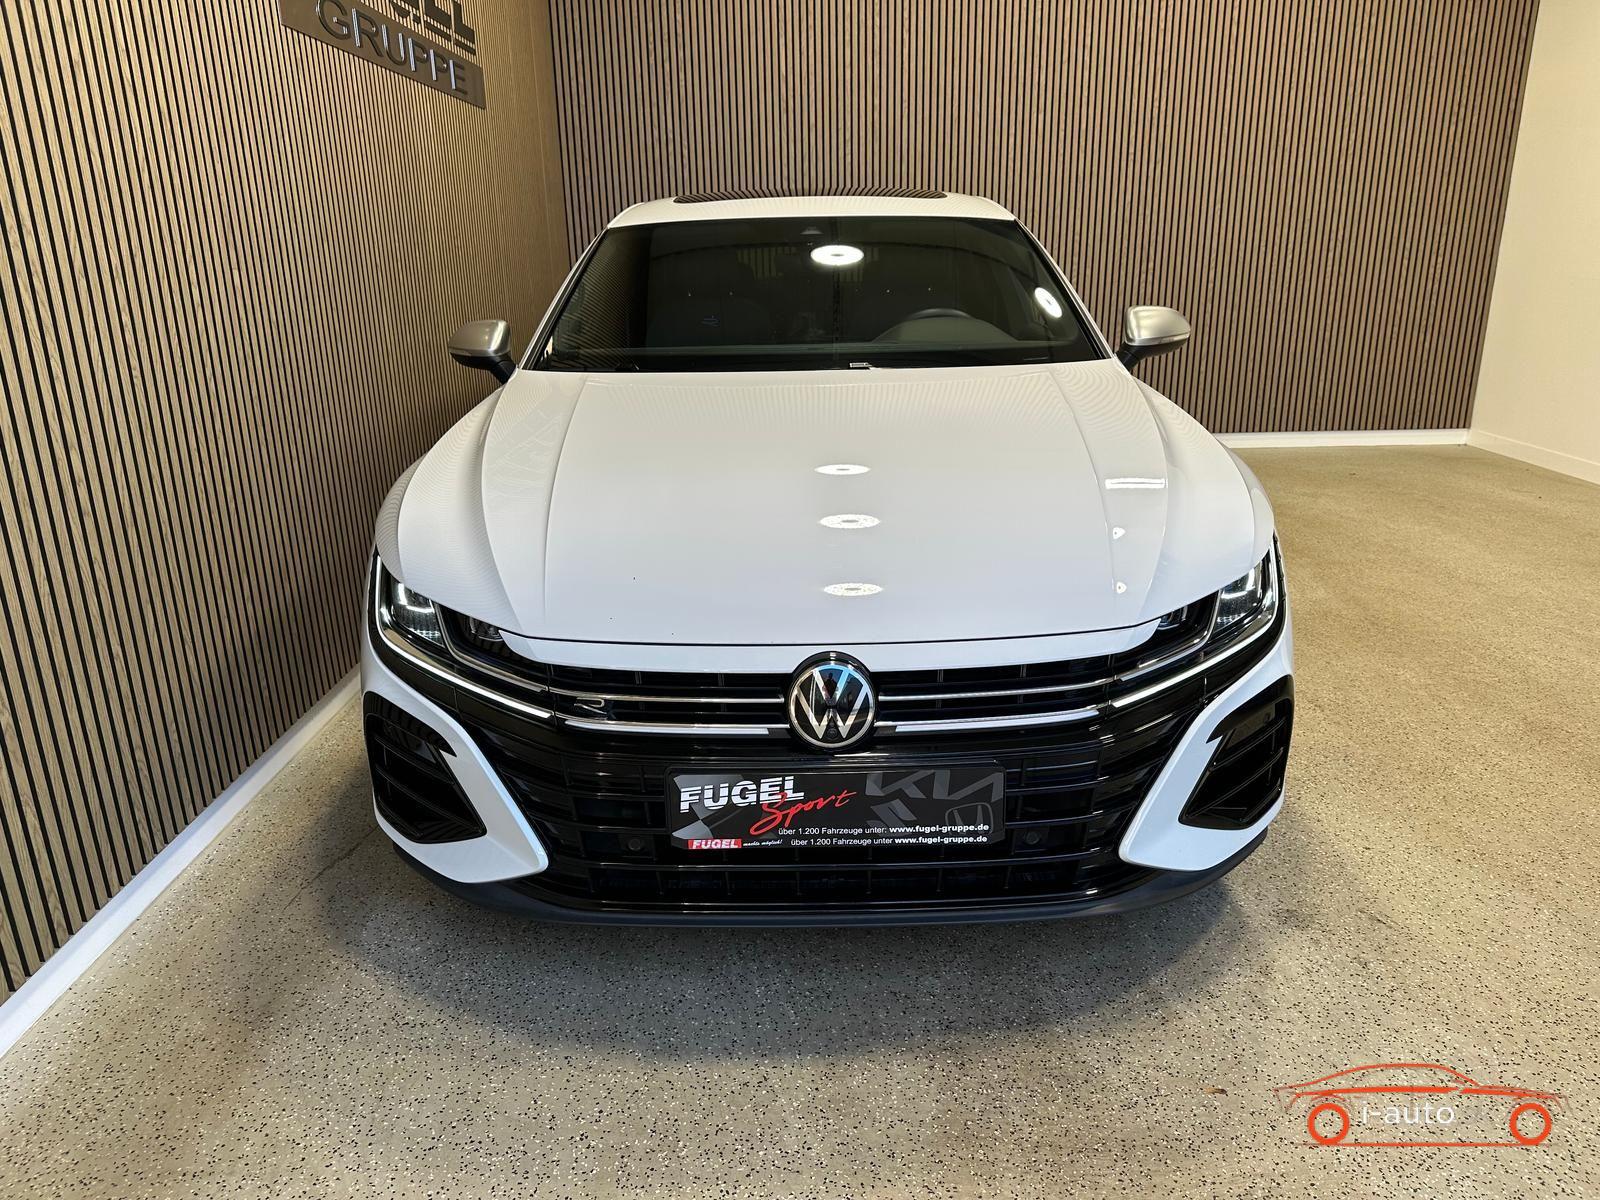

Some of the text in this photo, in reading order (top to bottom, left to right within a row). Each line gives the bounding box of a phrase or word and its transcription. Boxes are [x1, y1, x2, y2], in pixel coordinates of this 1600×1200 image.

[316, 0, 468, 95] GRUPPE
[679, 776, 804, 813] FUGEL
[750, 790, 857, 836] Sport
[790, 835, 988, 846] über 1.200 Fahrzeuge unter www.fugel-gruppe.de
[798, 827, 820, 835] 1.200
[821, 826, 863, 834] Fahrzeuge
[864, 826, 888, 834] unter:
[889, 824, 990, 834] www.fugel-gruppe.de
[692, 839, 739, 849] FUGEL
